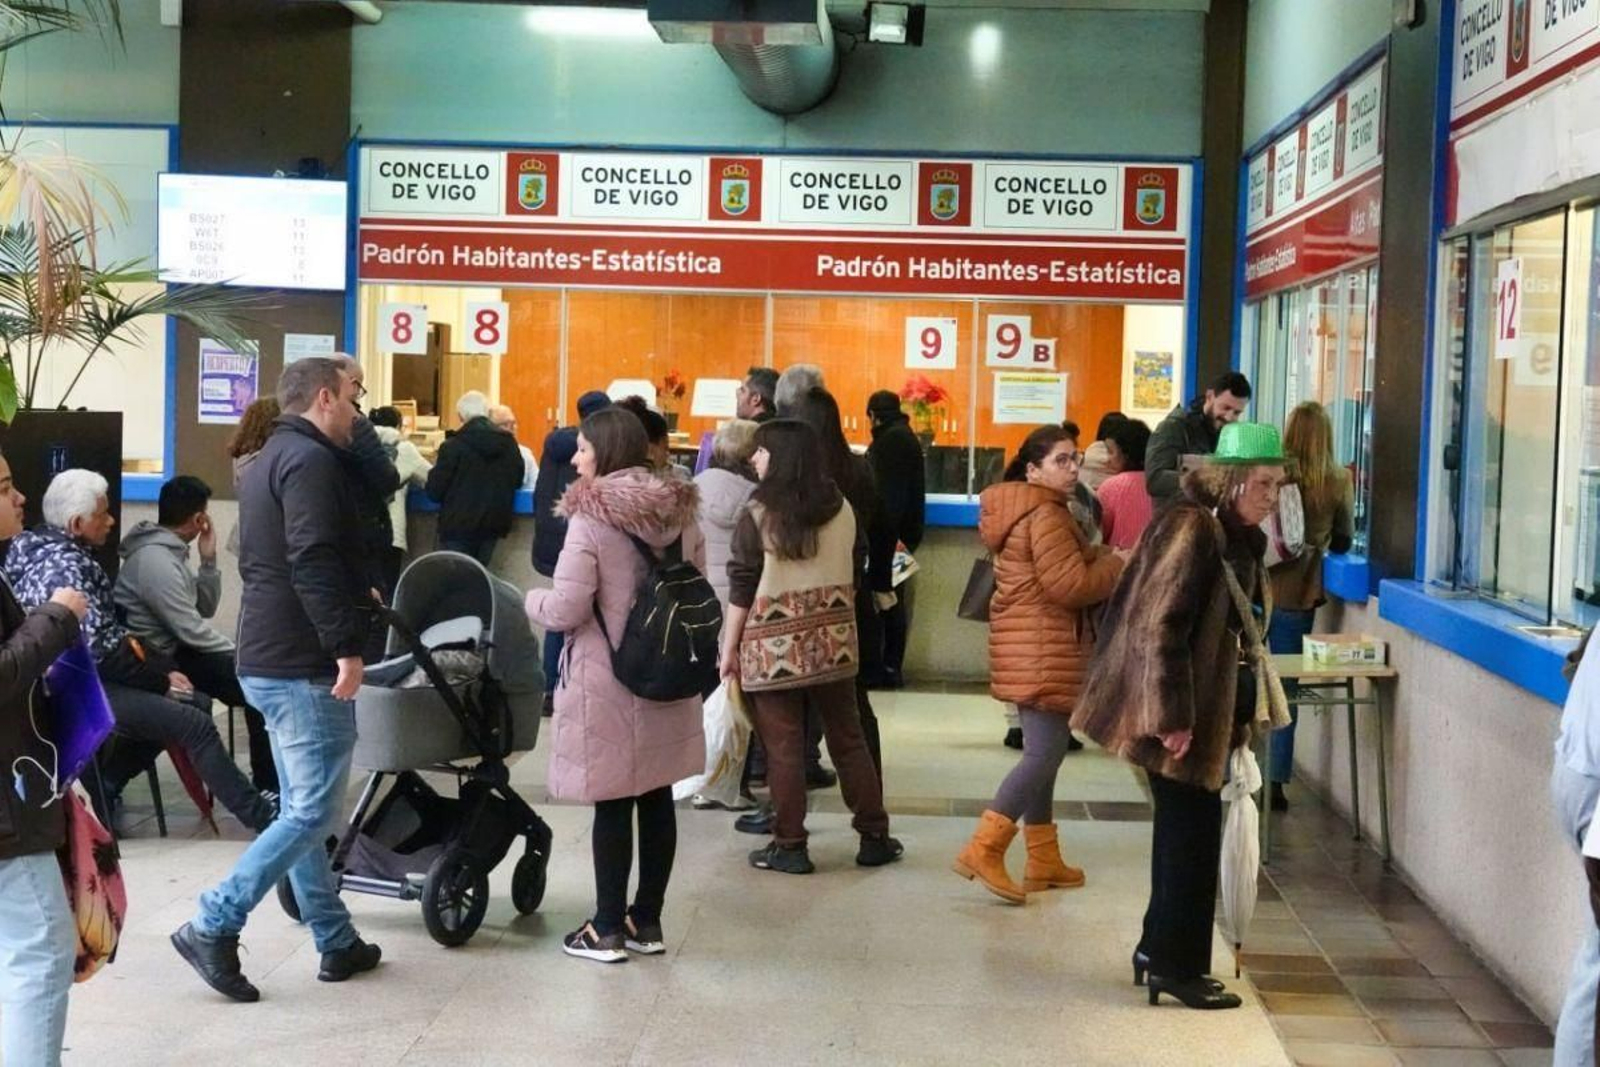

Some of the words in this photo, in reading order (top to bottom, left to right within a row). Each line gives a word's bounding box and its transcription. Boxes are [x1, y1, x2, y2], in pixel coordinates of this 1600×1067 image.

[1462, 49, 1474, 81] DE
[1476, 35, 1496, 72] VIGO
[379, 161, 490, 180] CONCELLO
[581, 167, 693, 186] CONCELLO
[789, 171, 902, 191] CONCELLO
[392, 183, 419, 200] DE
[428, 184, 477, 202] VIGO
[594, 188, 621, 205] DE
[629, 189, 679, 207] VIGO
[994, 176, 1108, 196] CONCELLO
[802, 193, 830, 210] DE
[838, 194, 888, 212] VIGO
[1007, 198, 1035, 215] DE
[1043, 198, 1094, 217] VIGO
[362, 242, 445, 266] Padrón
[452, 245, 722, 275] Habitantes-Estatística
[817, 253, 900, 278] Padrón
[908, 257, 1182, 286] Habitantes-Estatística
[1498, 278, 1518, 340] 12
[392, 311, 413, 344] 8
[473, 308, 501, 346] 8
[920, 327, 942, 359] 9
[995, 322, 1022, 359] 9
[1033, 344, 1051, 362] B
